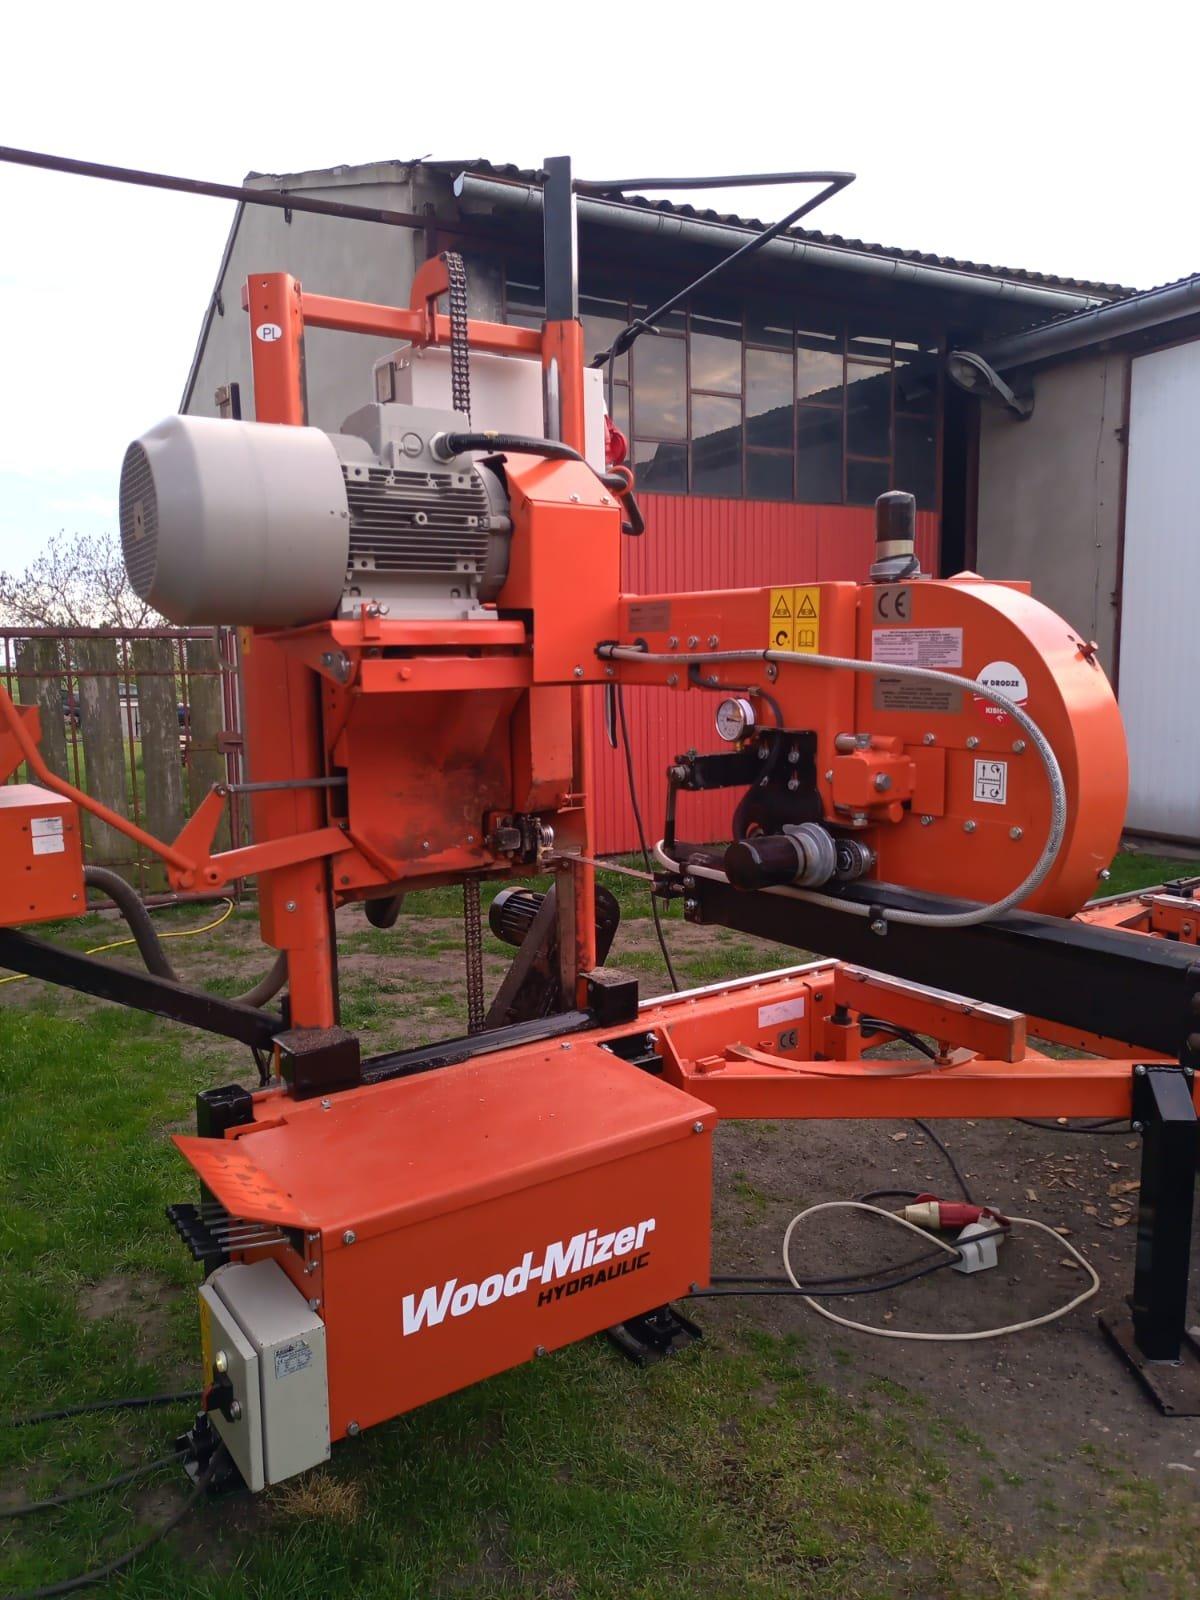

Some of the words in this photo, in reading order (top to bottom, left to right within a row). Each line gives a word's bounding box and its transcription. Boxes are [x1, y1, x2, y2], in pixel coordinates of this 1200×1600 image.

[263, 327, 280, 339] PL
[878, 592, 906, 618] CE
[981, 679, 989, 687] W
[990, 679, 1019, 687] DRODZE
[402, 1218, 655, 1337] Wood-Mizer
[537, 1252, 650, 1306] HYDRAULIC
